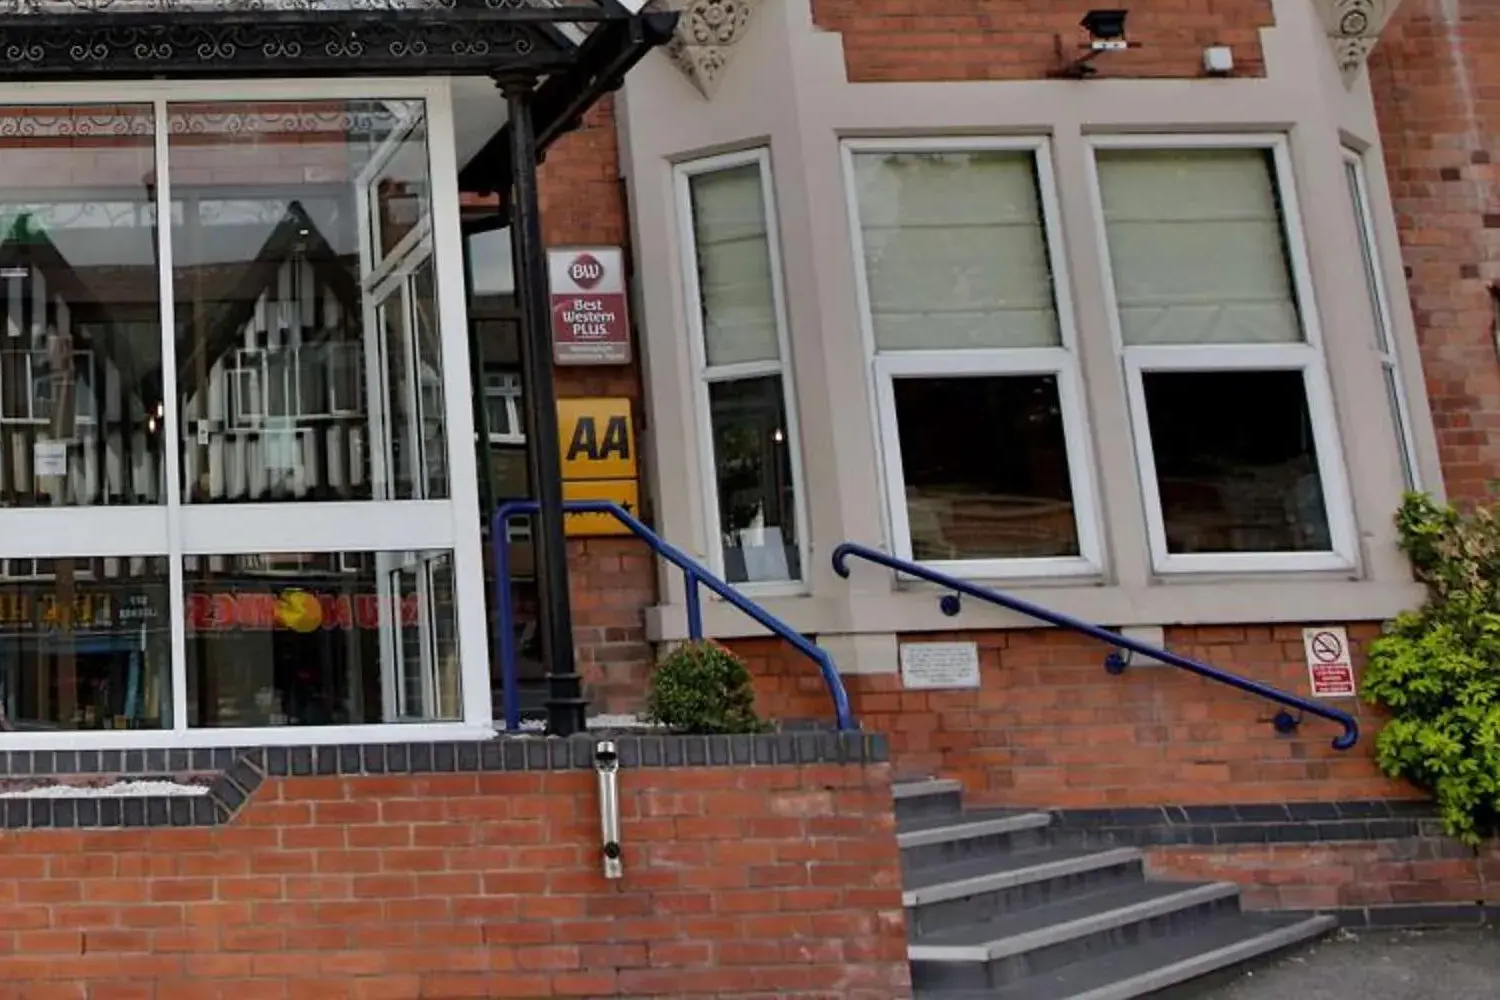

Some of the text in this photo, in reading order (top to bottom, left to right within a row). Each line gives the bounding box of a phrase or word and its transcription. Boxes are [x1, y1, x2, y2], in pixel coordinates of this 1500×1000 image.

[573, 263, 599, 279] BW
[575, 299, 603, 311] Best
[563, 311, 615, 323] Western
[573, 323, 607, 335] PLUS
[566, 415, 630, 461] AA
